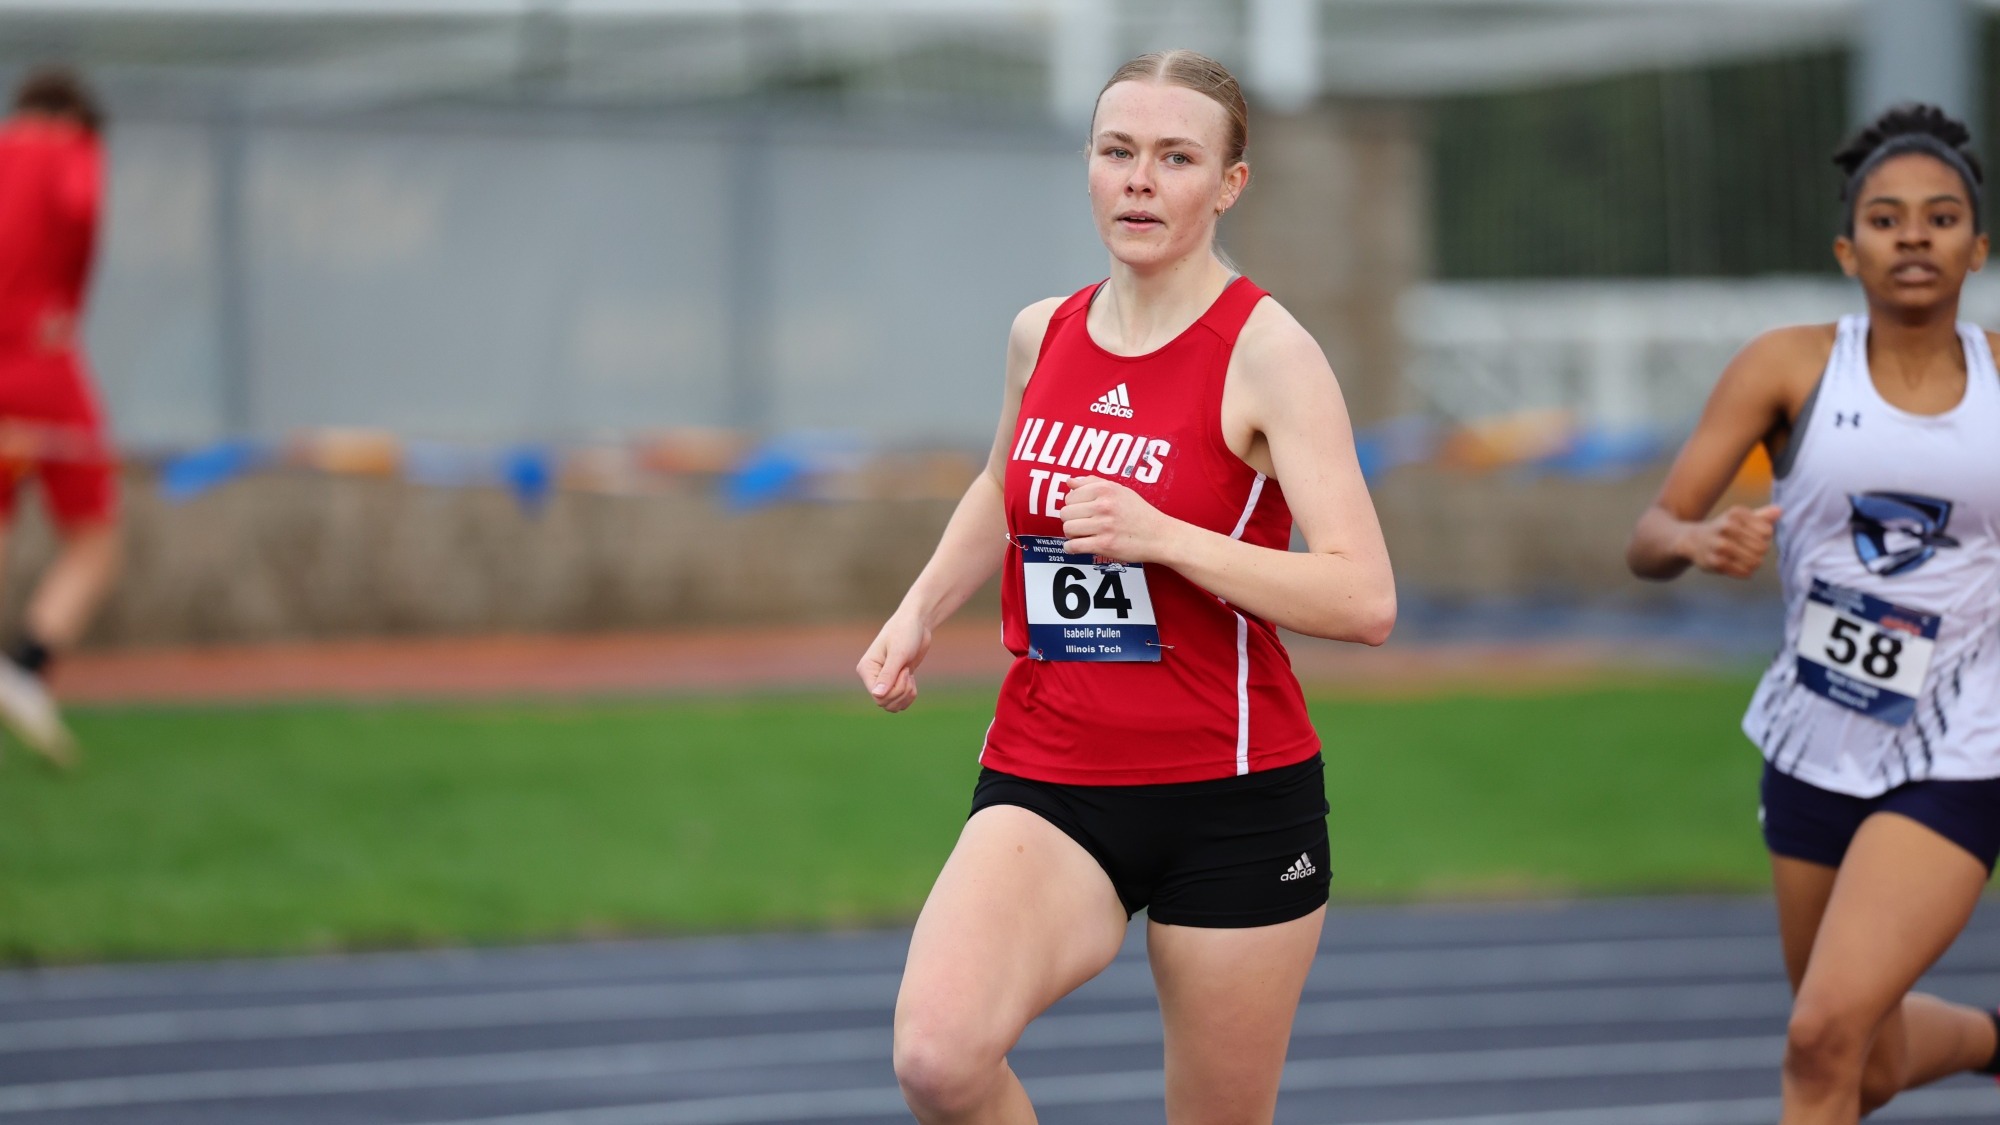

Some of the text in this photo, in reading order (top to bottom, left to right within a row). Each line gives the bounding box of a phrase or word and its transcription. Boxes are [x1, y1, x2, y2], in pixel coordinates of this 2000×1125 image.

[1090, 401, 1134, 419] adidas
[1012, 417, 1171, 484] ILLINOIS
[1028, 468, 1080, 519] TE
[1053, 566, 1132, 620] 64
[1063, 627, 1121, 639] Isabelle Pullen
[1065, 644, 1122, 653] Illinois Tech
[1824, 616, 1903, 679] 58
[1280, 865, 1316, 882] adidas
